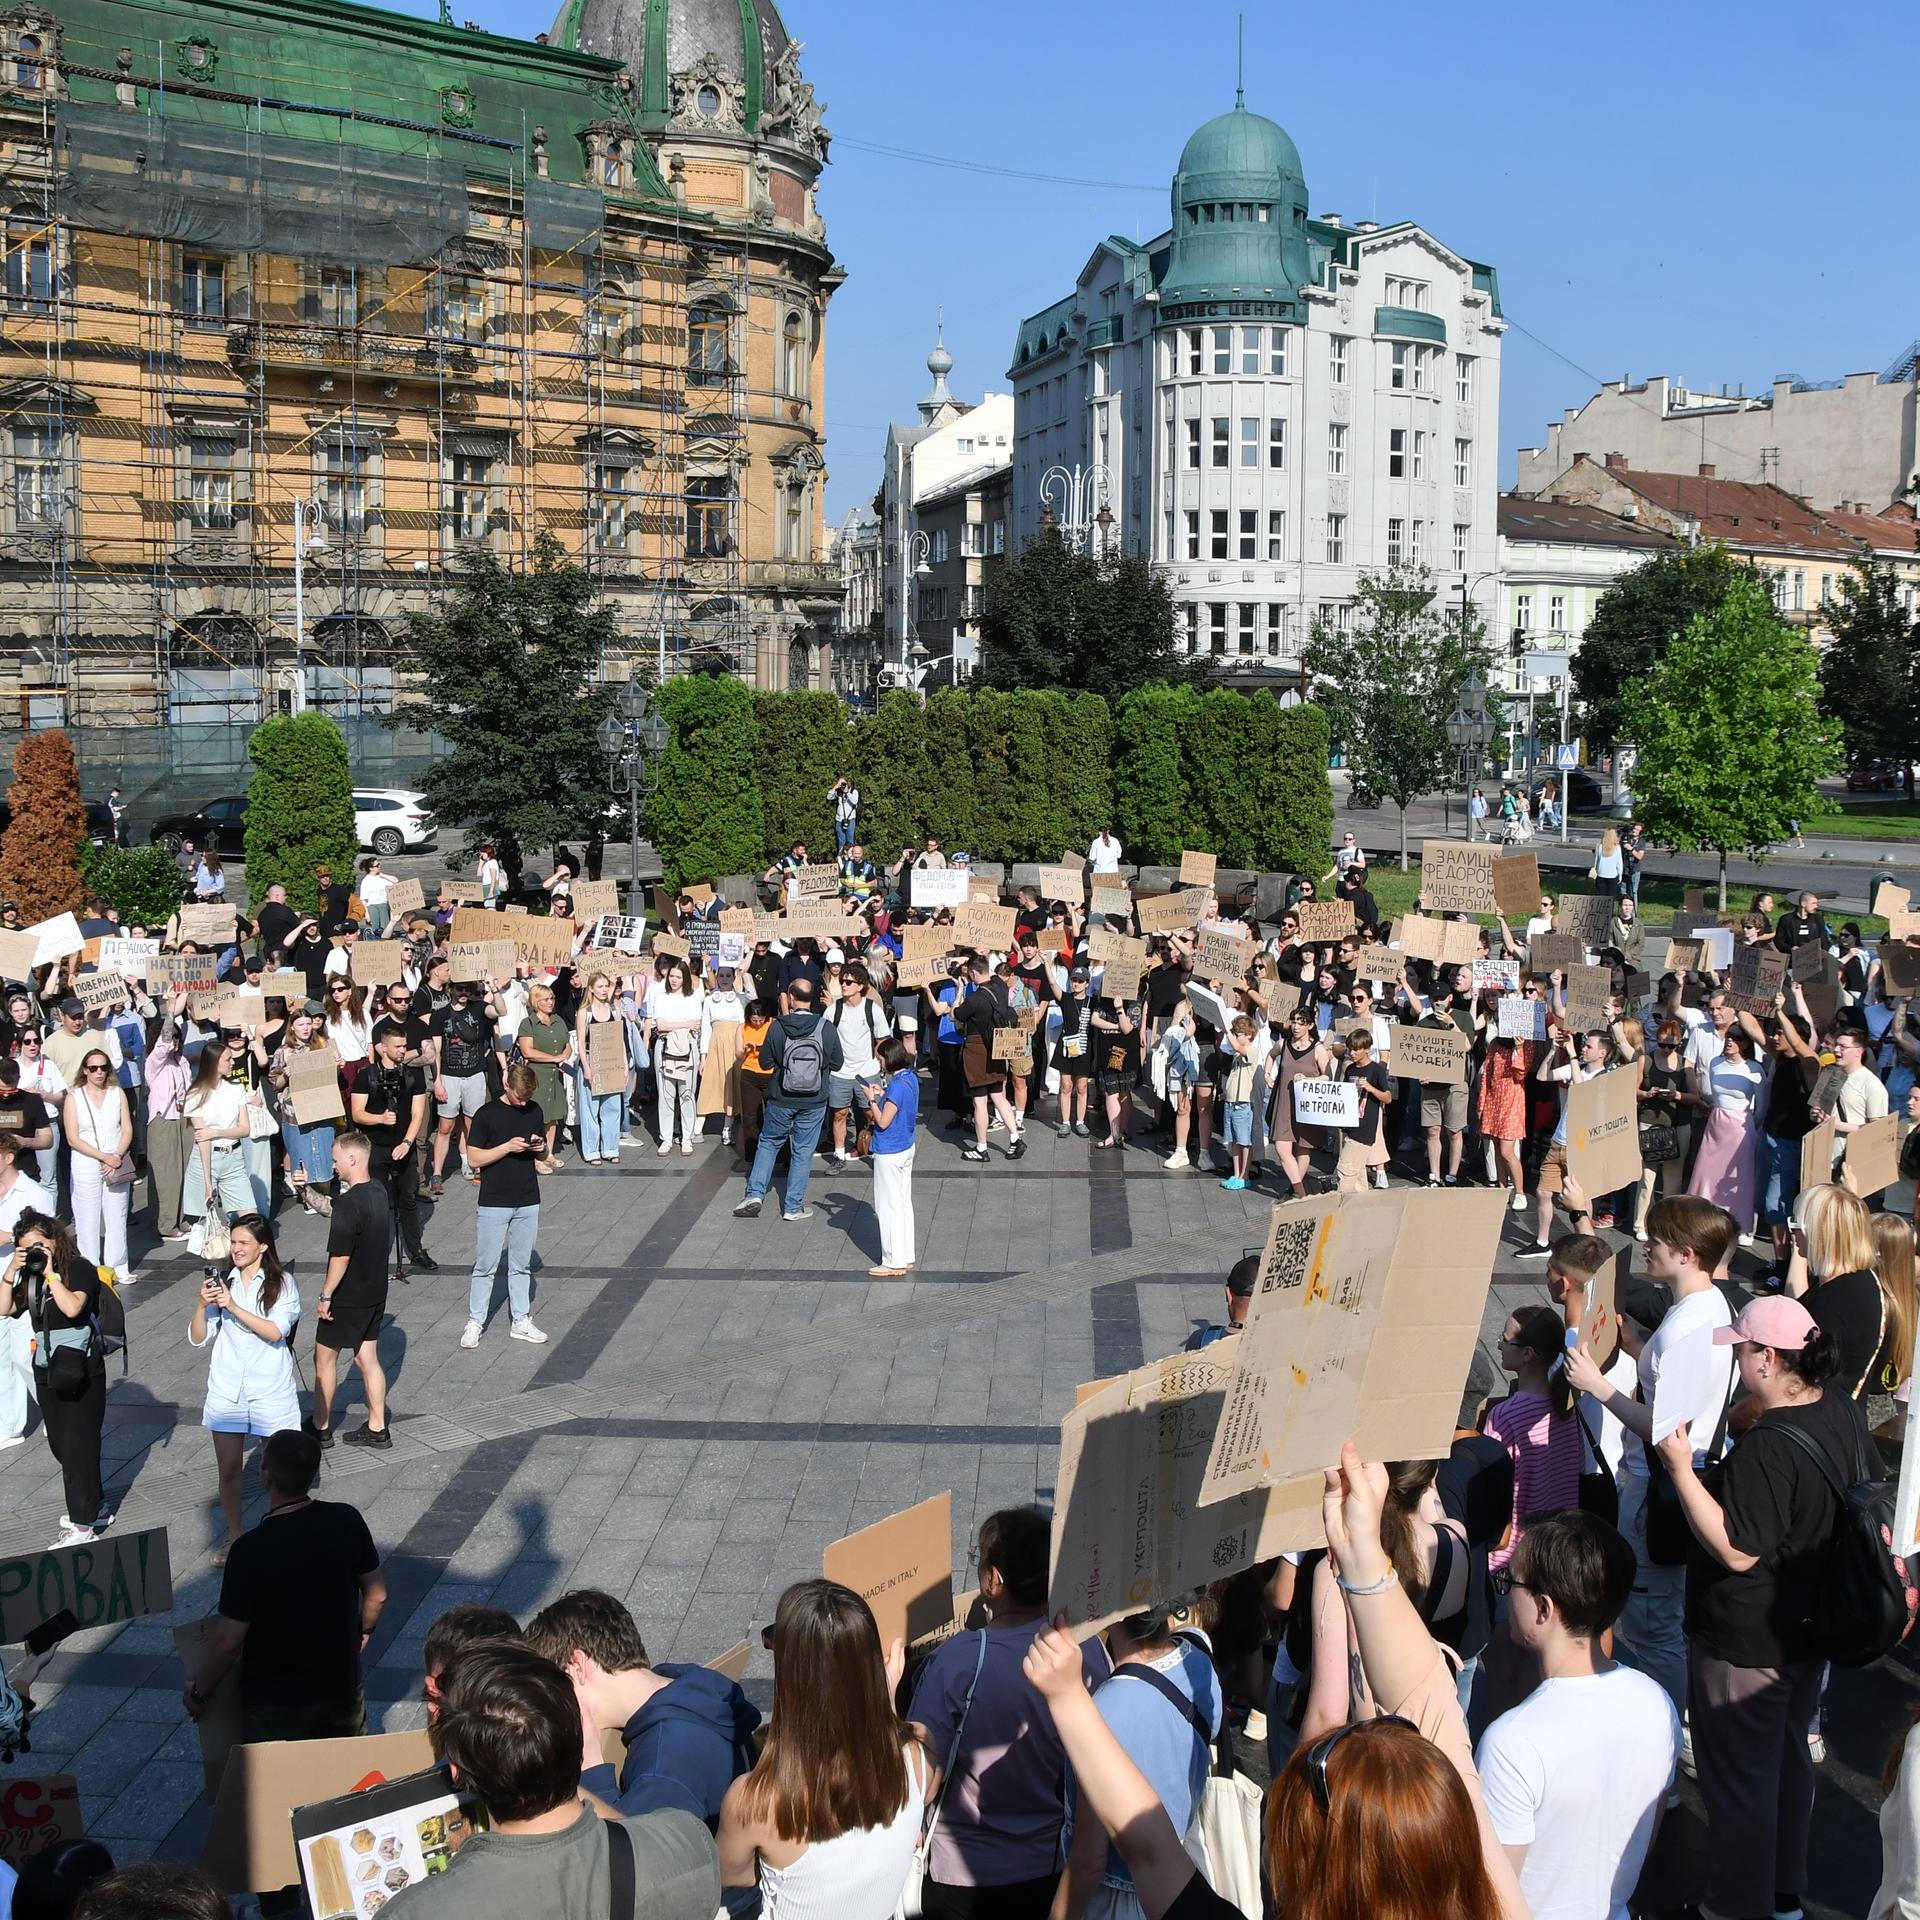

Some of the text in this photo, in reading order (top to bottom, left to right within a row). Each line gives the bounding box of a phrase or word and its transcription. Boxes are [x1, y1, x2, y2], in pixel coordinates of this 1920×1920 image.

[1229, 303, 1287, 318] ЦЕНТР
[1234, 659, 1265, 670] БАНК
[912, 870, 955, 882] ФЕДОРОВ
[1052, 884, 1074, 896] МО
[1424, 882, 1495, 900] МІНІСТРОМ
[1299, 901, 1352, 917] СКАЖИ НІ
[1432, 895, 1492, 912] ОБОРОНИ
[967, 908, 1010, 926] ПОЛІГРАФ
[1139, 906, 1156, 923] НЕ
[1301, 913, 1348, 927] РУЧНОМУ
[1089, 942, 1103, 953] НЕ
[1205, 934, 1231, 951] КРАЇНІ
[450, 945, 481, 957] НАЩО
[150, 956, 213, 971] НАСТУПНЕ
[900, 962, 926, 980] БАНДУ
[1475, 960, 1518, 973] ФЕДОРОВ
[75, 971, 125, 994] ПОВЕРНІТЬ
[168, 967, 202, 982] СЛОВО
[152, 979, 217, 994] ЗА НАРОДОМ
[80, 989, 127, 1008] ФЕДОРОВА
[1402, 1032, 1454, 1047] ЗАЛИШТЕ
[1399, 1042, 1465, 1060] ЕФЕКТИВНИХ
[1400, 1052, 1453, 1070] ЛЮДЕЙ
[1302, 1082, 1342, 1097] РАБОТАЄ
[1311, 1099, 1346, 1115] ТРОГАЙ
[1212, 1413, 1236, 1481] СТВОРЮЙТЕ
[1230, 1396, 1240, 1411] ТА
[1220, 1393, 1247, 1479] ВІДПРАВЛЕННЯ
[1134, 1475, 1151, 1576] УКРПОШТА
[862, 1565, 919, 1601] MADE IN ITALY
